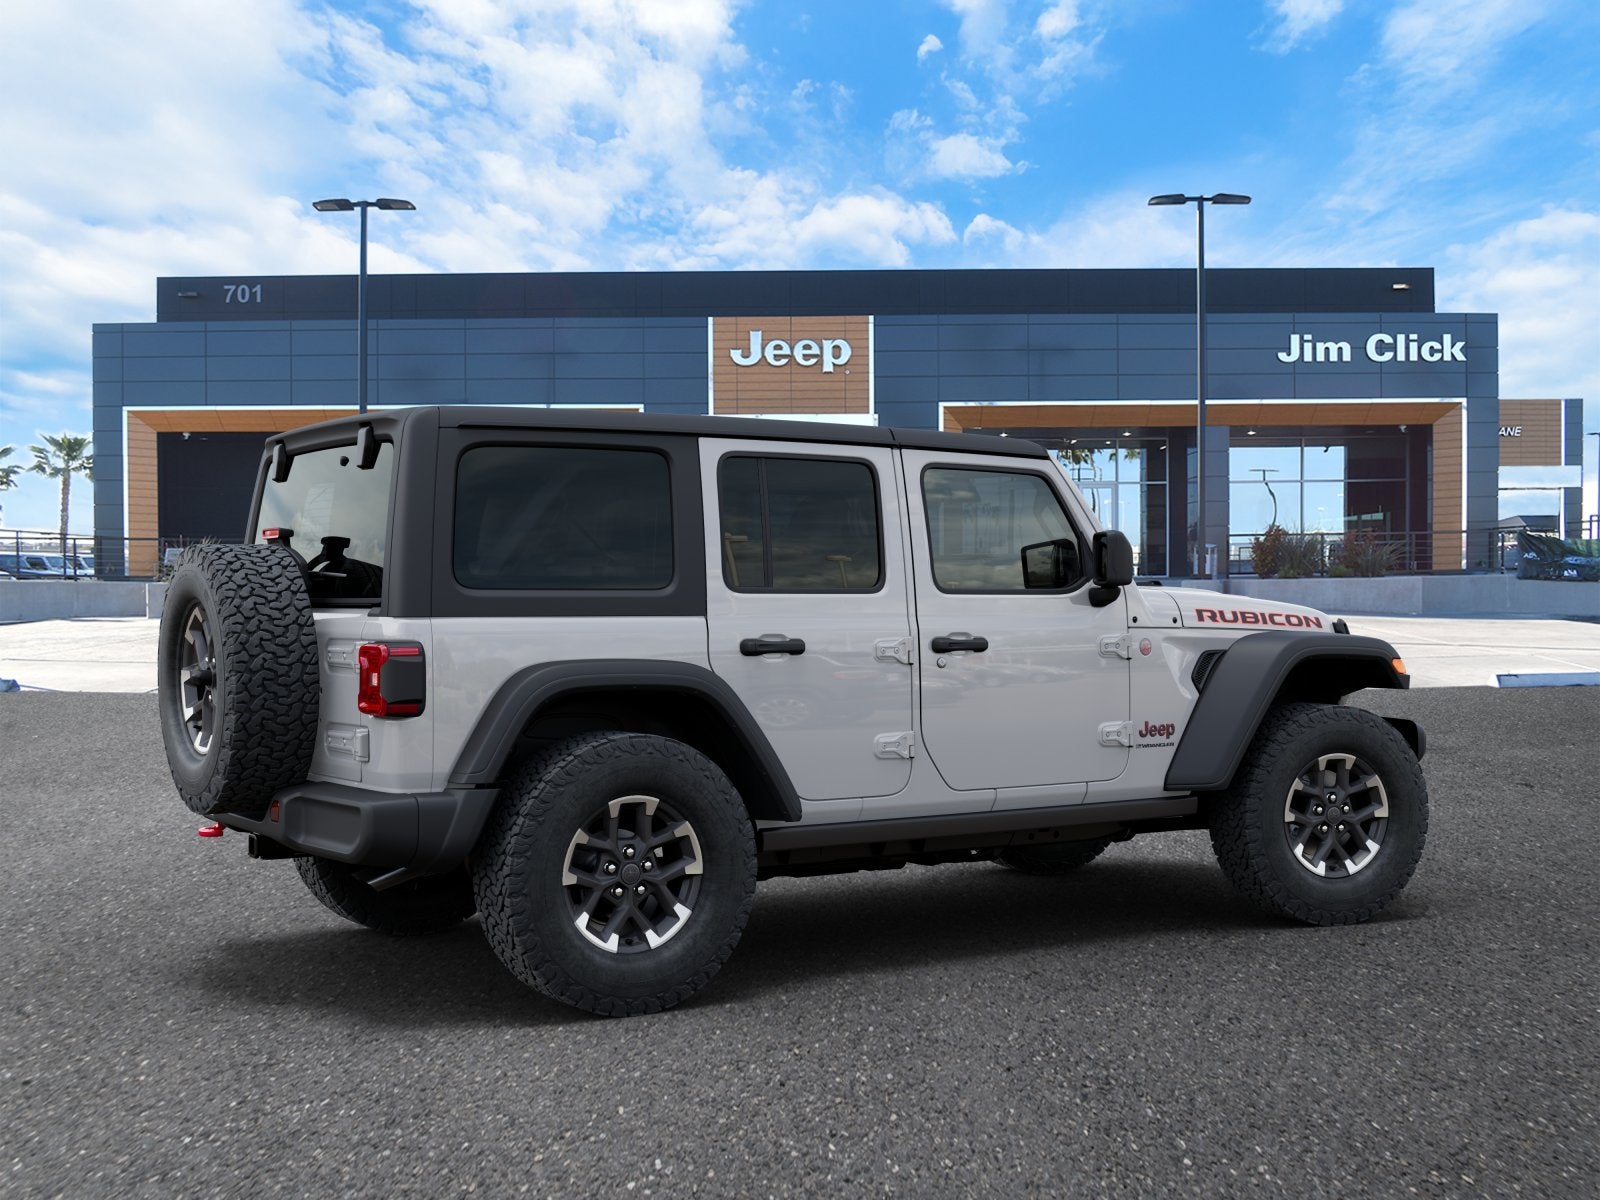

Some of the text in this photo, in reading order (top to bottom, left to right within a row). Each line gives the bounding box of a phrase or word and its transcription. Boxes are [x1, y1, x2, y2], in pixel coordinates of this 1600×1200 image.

[223, 284, 263, 304] 701
[729, 330, 852, 373] Jeep
[1277, 333, 1467, 363] Jim Click
[1195, 608, 1323, 629] RUBICON
[1138, 720, 1176, 739] Jeep
